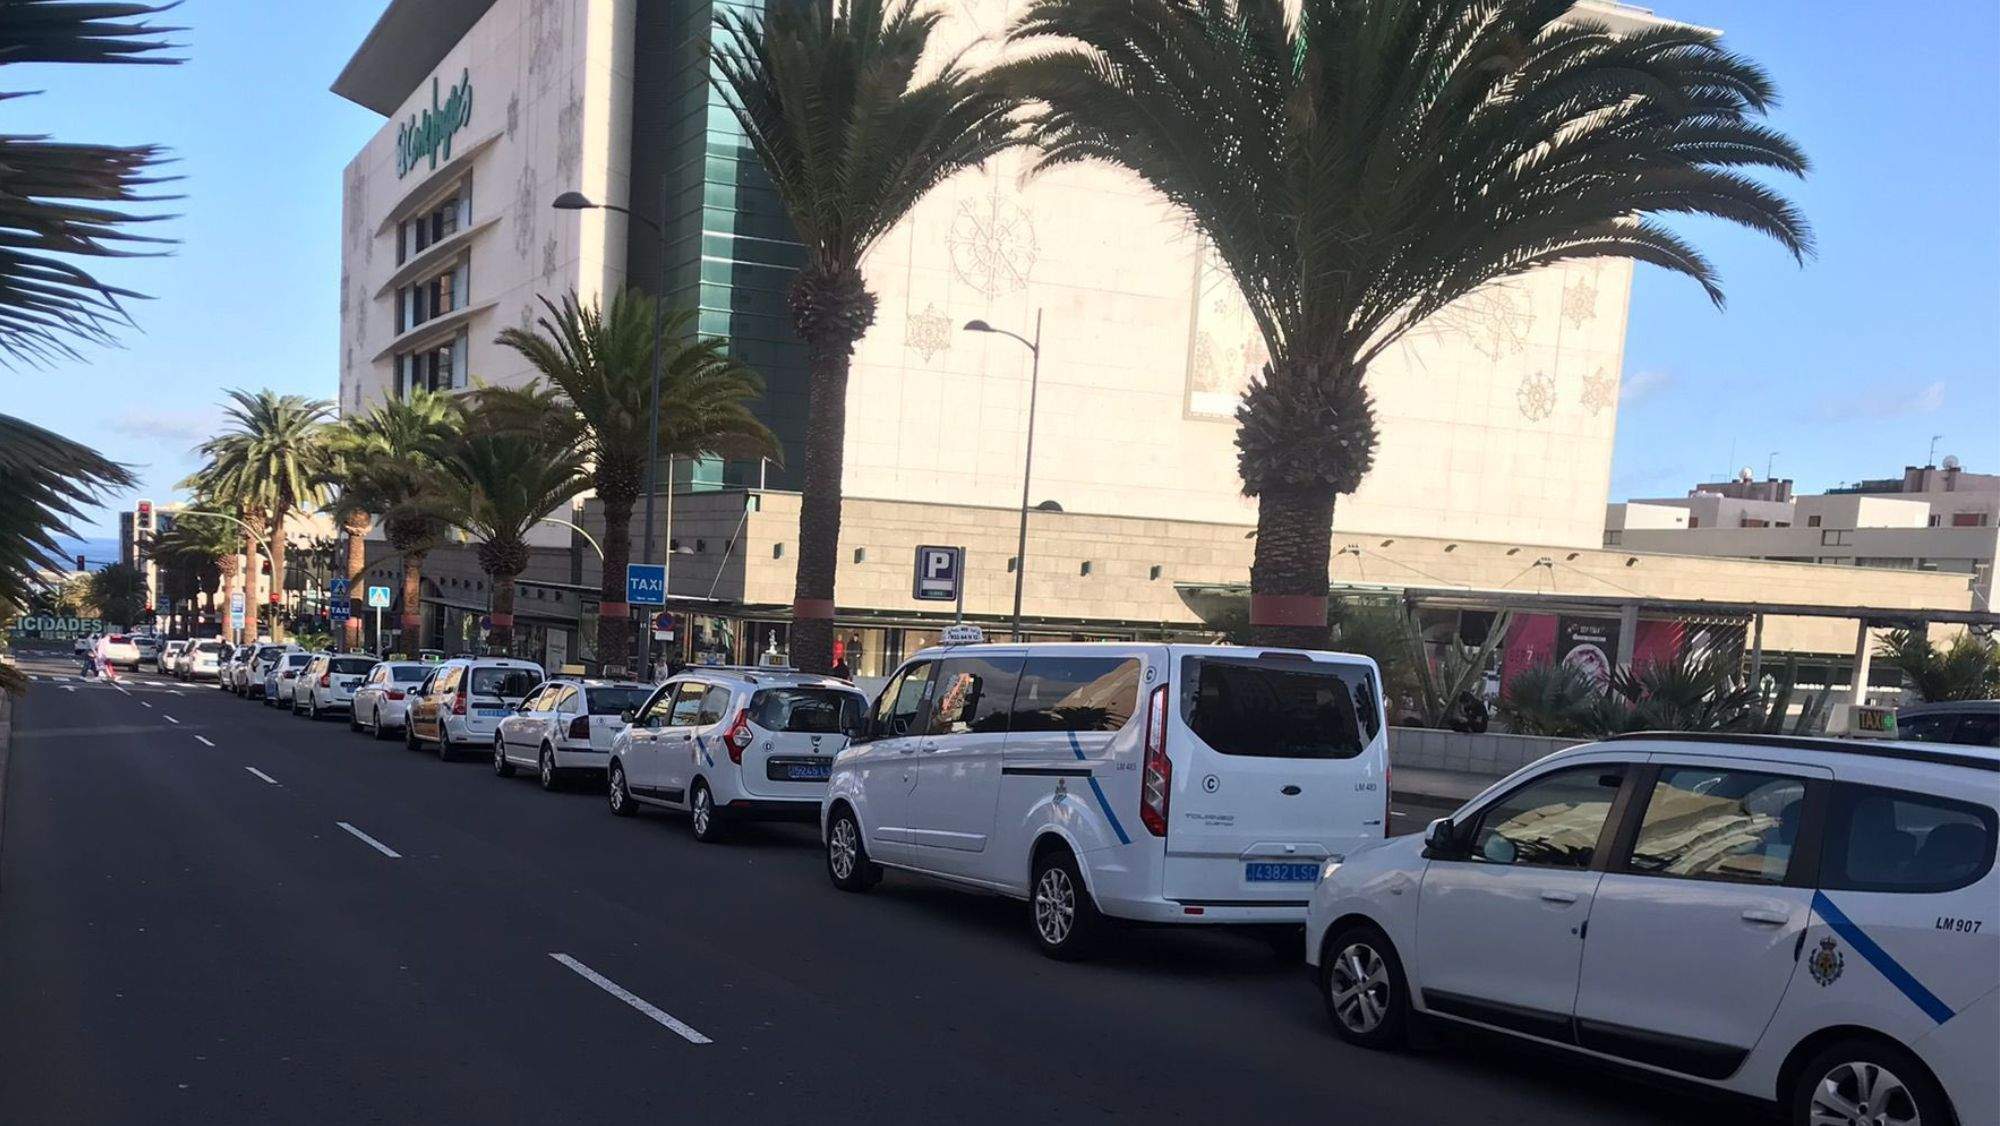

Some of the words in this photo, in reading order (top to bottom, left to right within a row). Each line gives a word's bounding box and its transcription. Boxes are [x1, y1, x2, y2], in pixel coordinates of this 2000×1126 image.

[928, 552, 950, 578] P
[630, 578, 662, 591] TAXI
[1256, 865, 1289, 880] 4382
[1935, 917, 1954, 930] LM
[1956, 919, 1982, 933] 907
